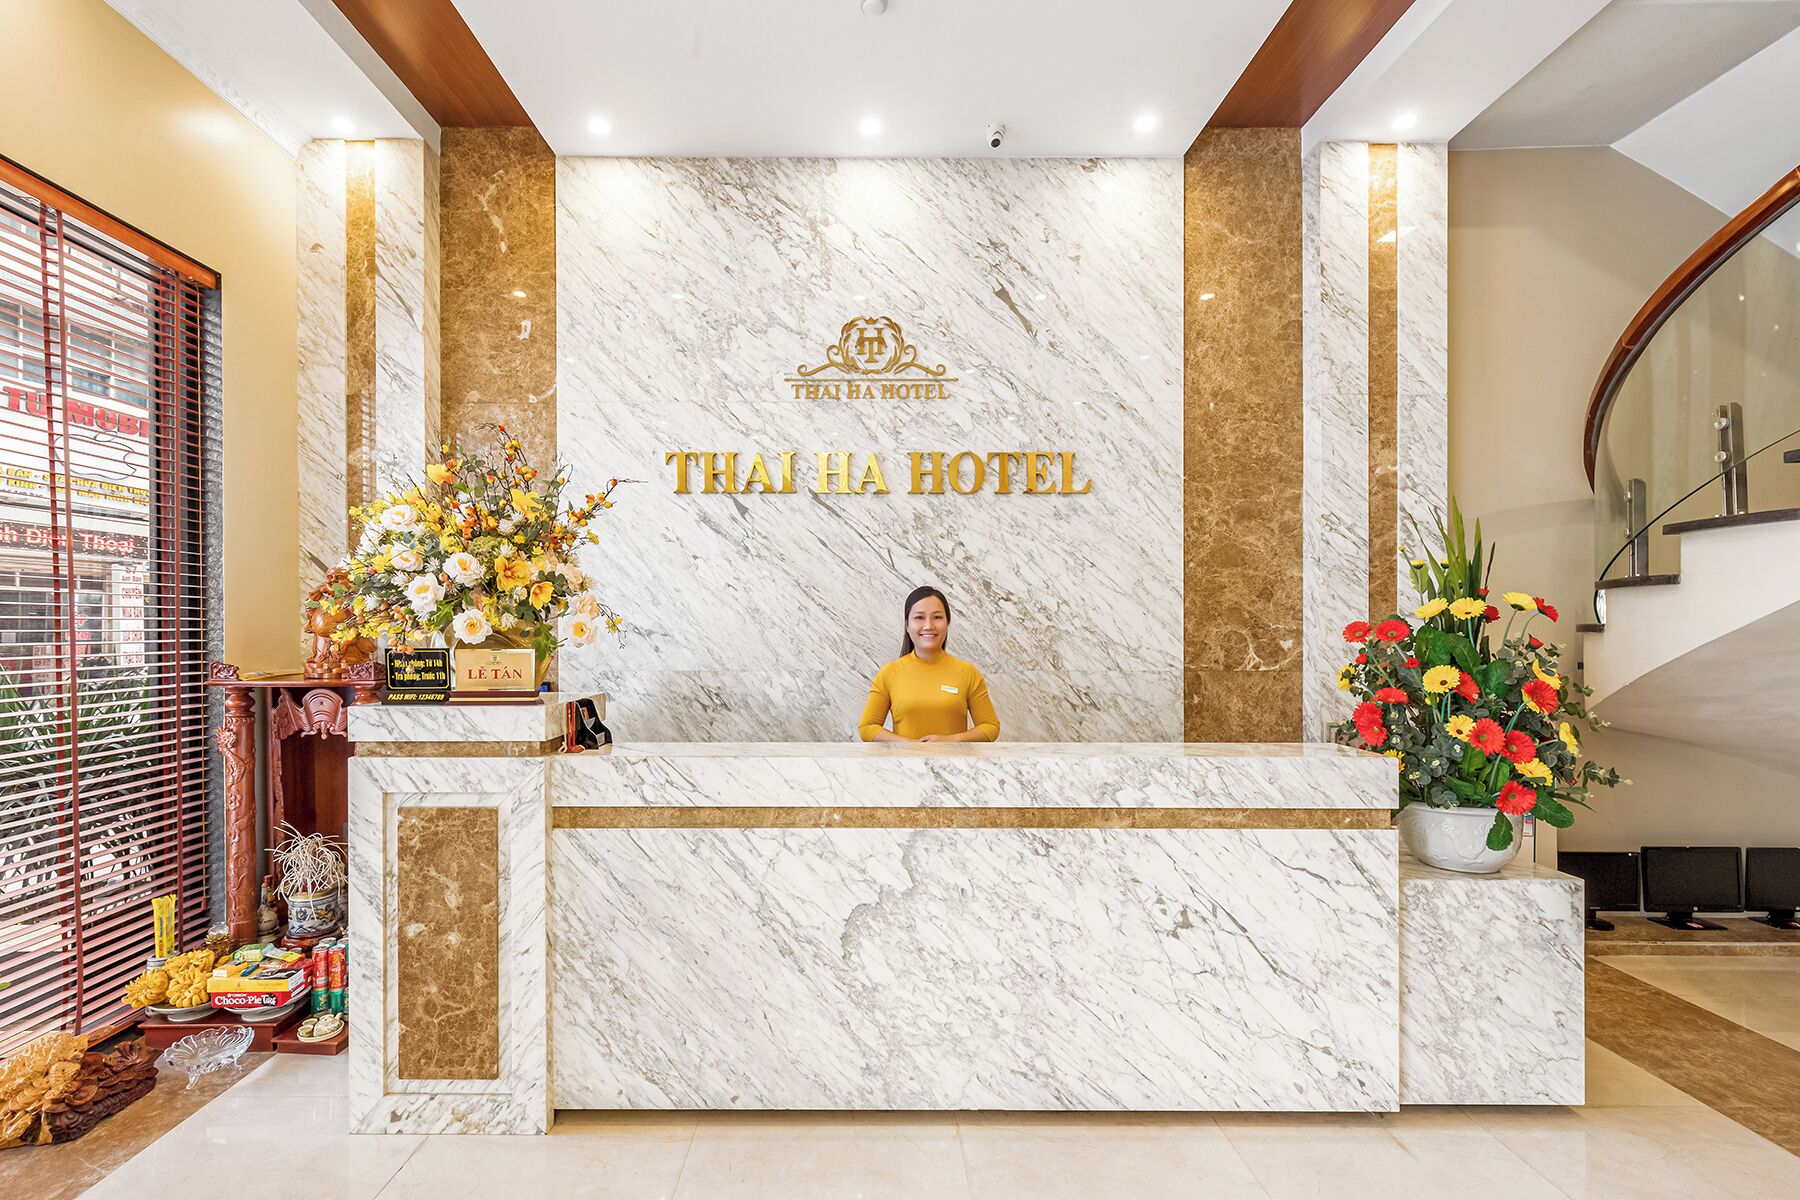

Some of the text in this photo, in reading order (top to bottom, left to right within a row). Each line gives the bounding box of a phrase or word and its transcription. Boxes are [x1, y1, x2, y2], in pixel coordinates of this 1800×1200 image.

[791, 384, 950, 400] THAI HA HOTEL
[665, 451, 1093, 494] THAI HA HOTEL
[215, 995, 262, 1005] Choco-Pie
